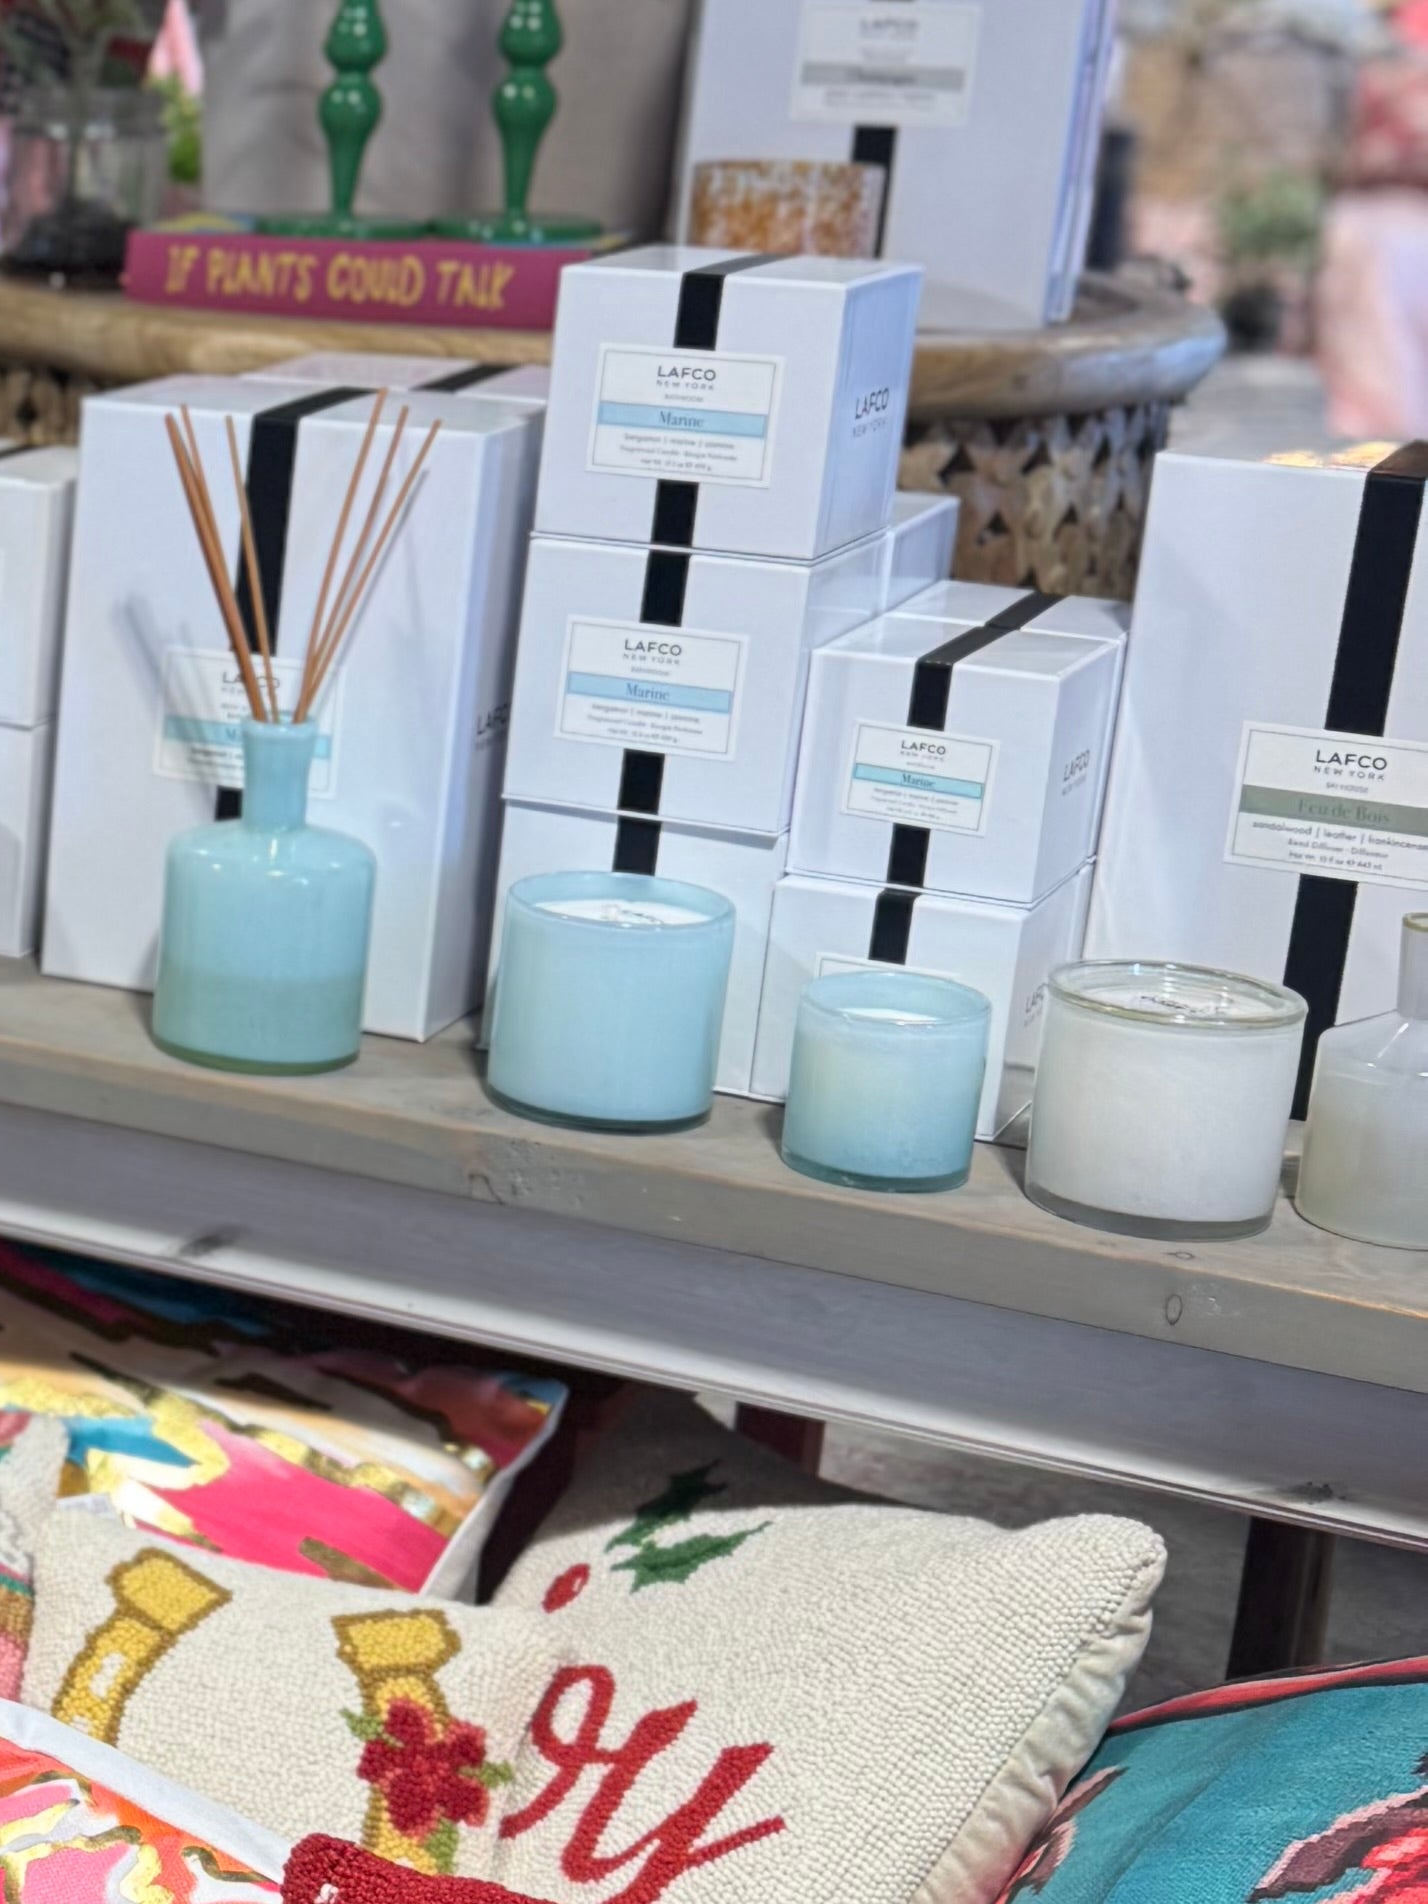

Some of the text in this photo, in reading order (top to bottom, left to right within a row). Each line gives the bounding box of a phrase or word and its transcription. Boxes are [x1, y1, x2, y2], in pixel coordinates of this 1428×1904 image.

[164, 244, 515, 310] IF PLANTS COULD TALK
[657, 366, 716, 381] LAFCO
[656, 380, 714, 390] NEW YORK
[855, 387, 890, 420] LAFCO
[659, 410, 704, 428] Marine
[624, 639, 682, 656] LAFCO
[626, 683, 669, 701] Marine
[901, 740, 946, 755] LAFCO
[1315, 750, 1387, 771] LAFCO
[1313, 765, 1385, 781] NEW YORK
[1297, 799, 1390, 824] Feu de Bois
